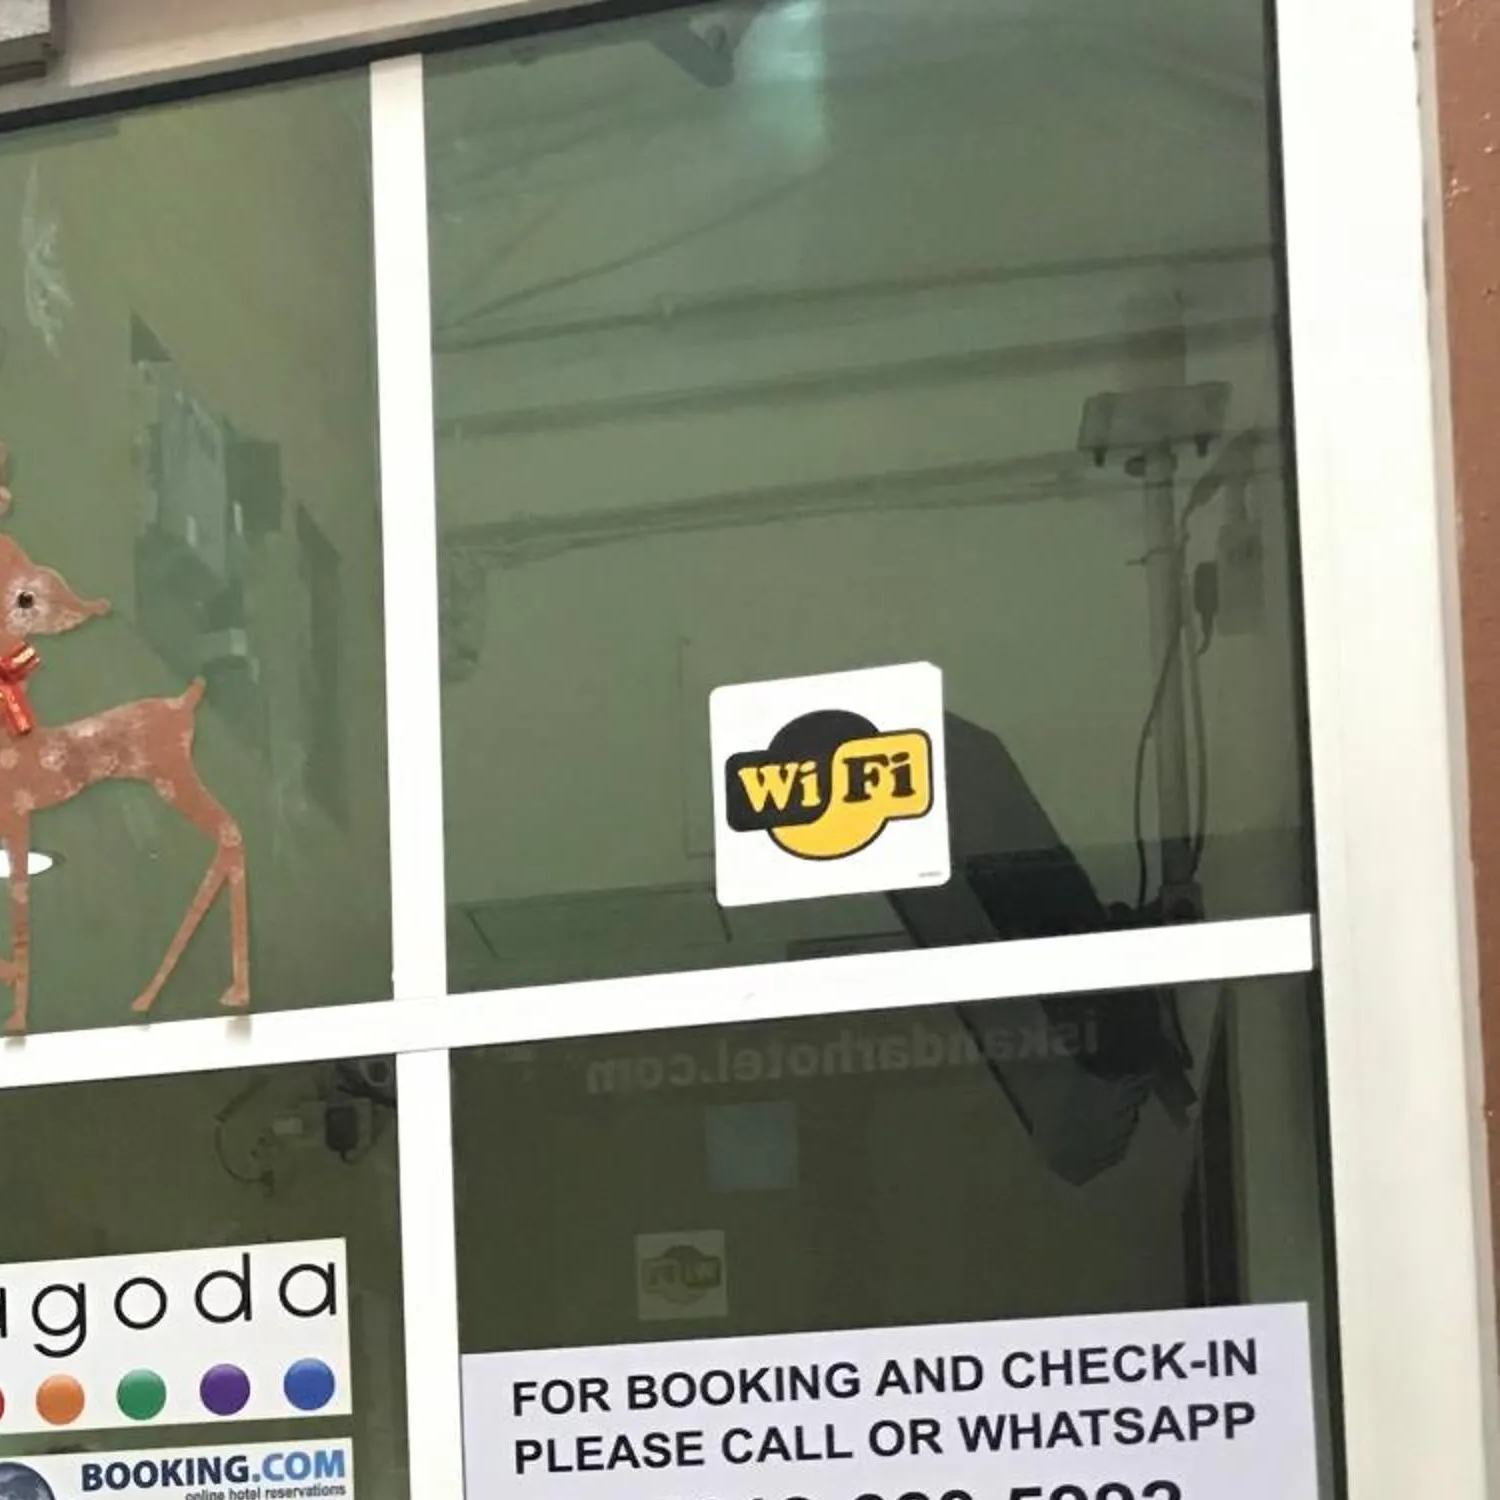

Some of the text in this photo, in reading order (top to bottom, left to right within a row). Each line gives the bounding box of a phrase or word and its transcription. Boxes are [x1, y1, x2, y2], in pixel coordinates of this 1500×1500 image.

[512, 1338, 1258, 1416] FOR BOOKING AND CHECK-IN
[515, 1401, 1256, 1474] PLEASE CALL OR WHATSAPP
[81, 1449, 346, 1492] BOOKING.COM
[228, 1486, 261, 1500] hotel
[265, 1481, 347, 1499] reservations
